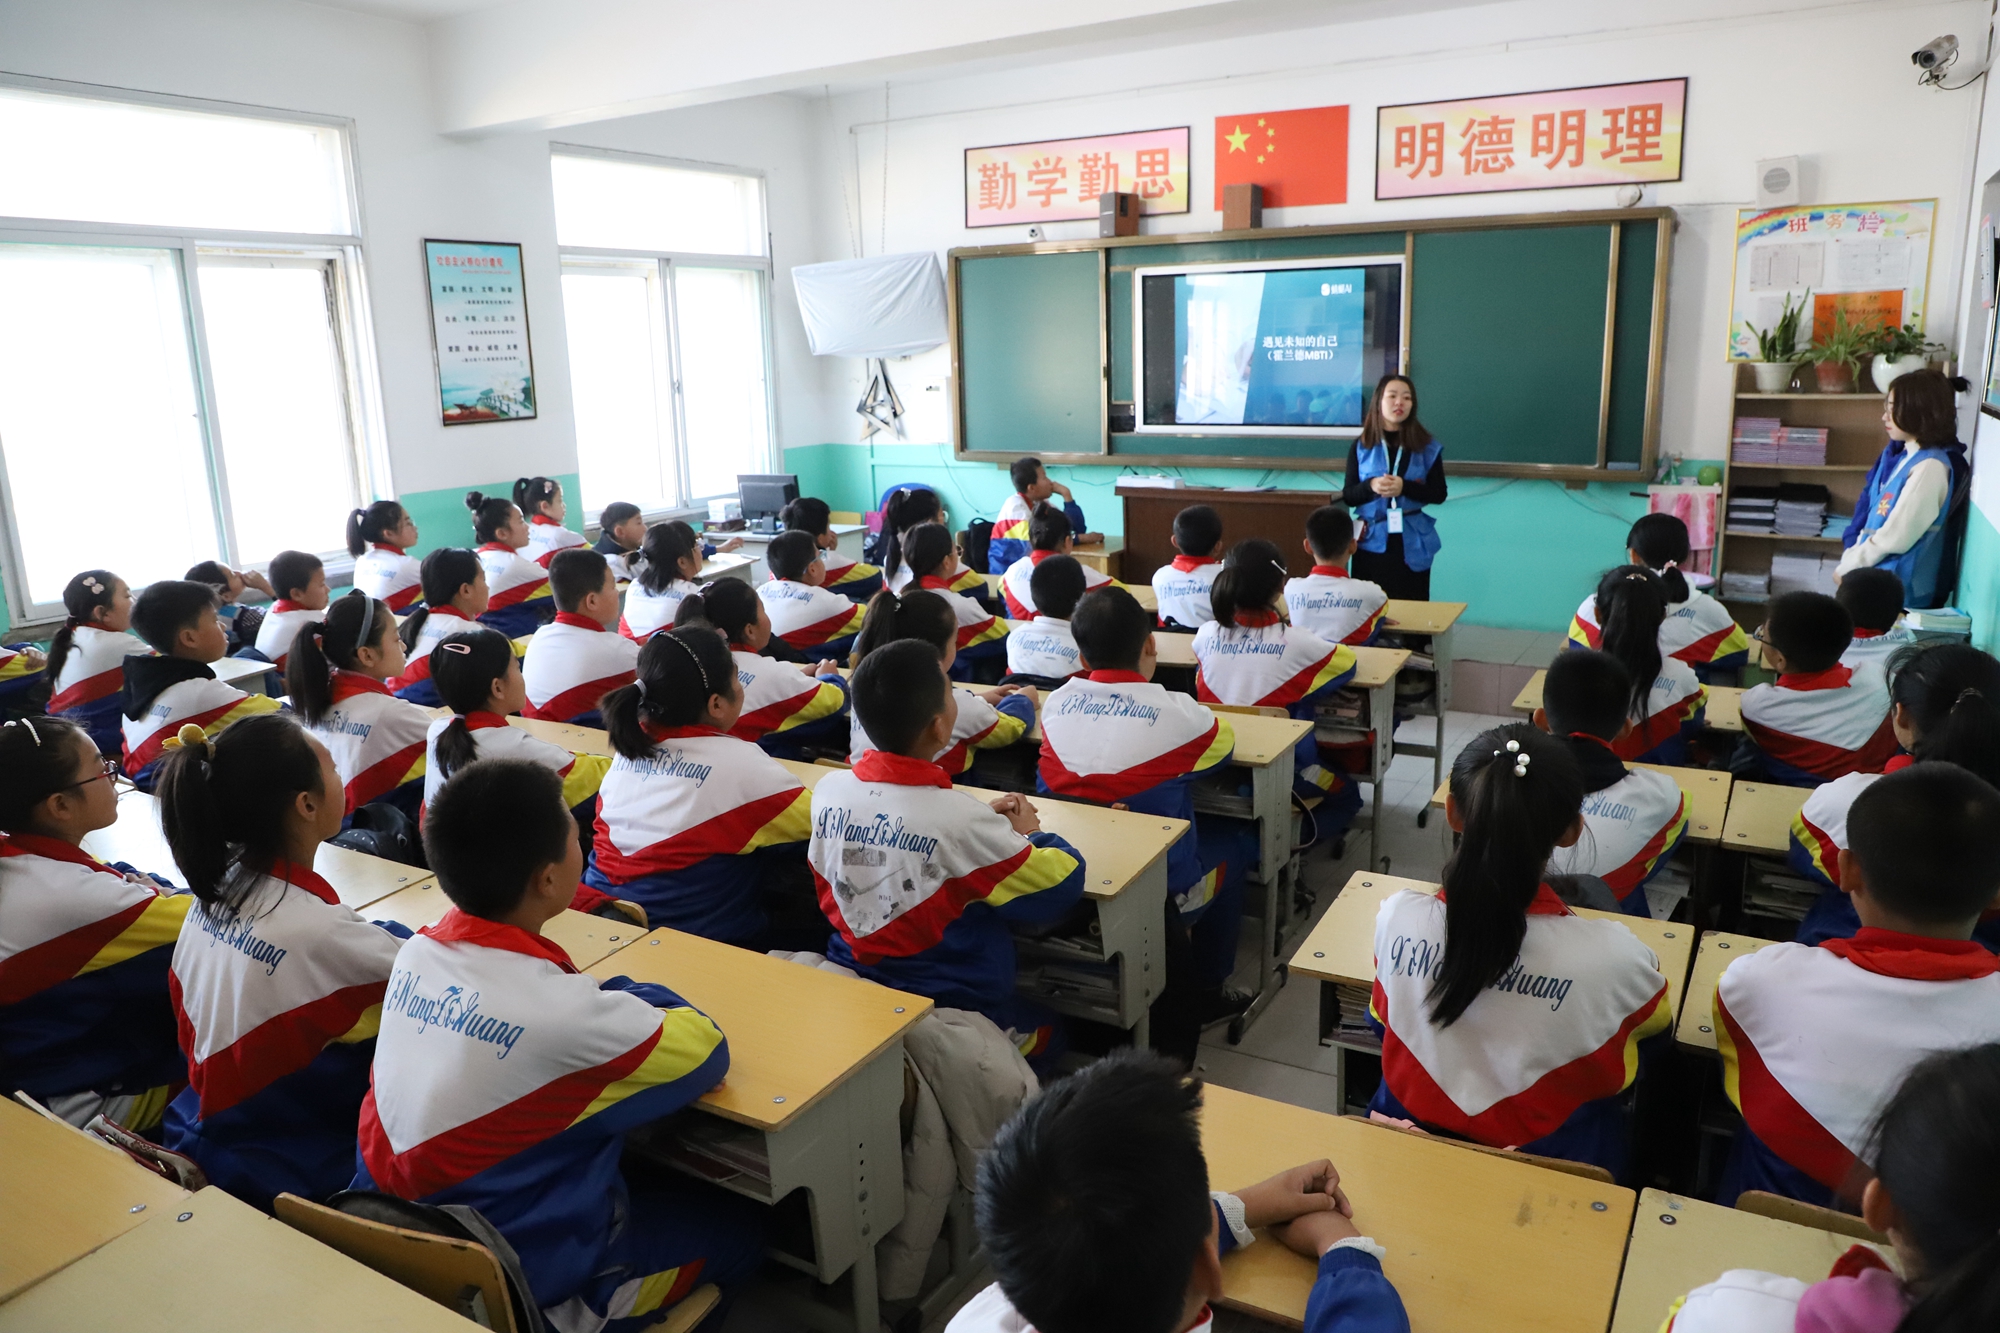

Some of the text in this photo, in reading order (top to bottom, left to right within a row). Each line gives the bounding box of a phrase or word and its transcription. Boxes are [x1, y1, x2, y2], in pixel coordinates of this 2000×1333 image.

[1394, 103, 1664, 180] 明德明理
[978, 148, 1175, 211] 勤学勤思
[1788, 213, 1881, 233] 班务栏
[1262, 335, 1338, 349] 遇见未知的自己
